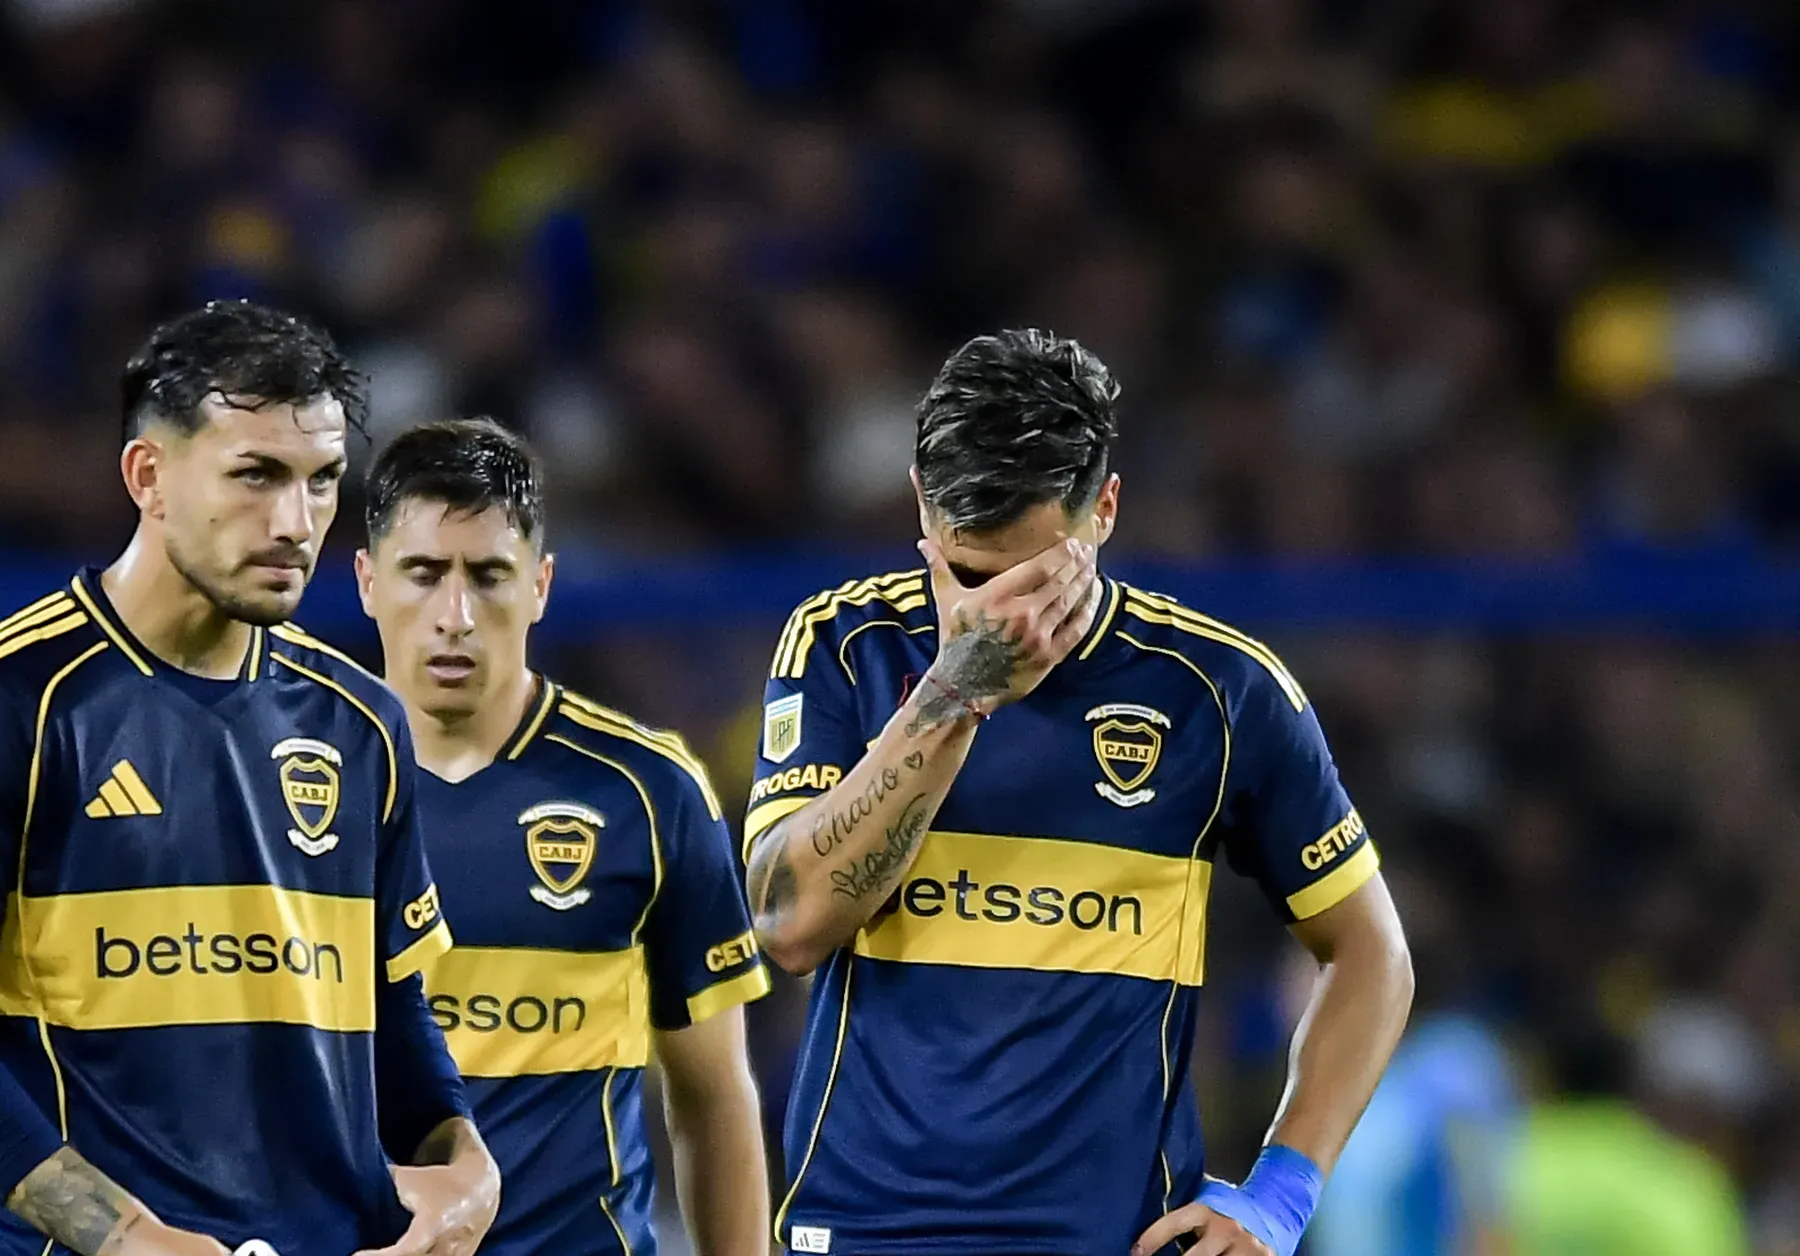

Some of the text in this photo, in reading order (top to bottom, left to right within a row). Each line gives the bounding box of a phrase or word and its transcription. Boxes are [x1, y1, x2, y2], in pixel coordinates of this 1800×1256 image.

[1105, 744, 1149, 760] CABJ
[291, 786, 328, 801] CABJ
[540, 846, 583, 859] CABJ
[882, 869, 1142, 935] etsson
[96, 922, 343, 983] betsson
